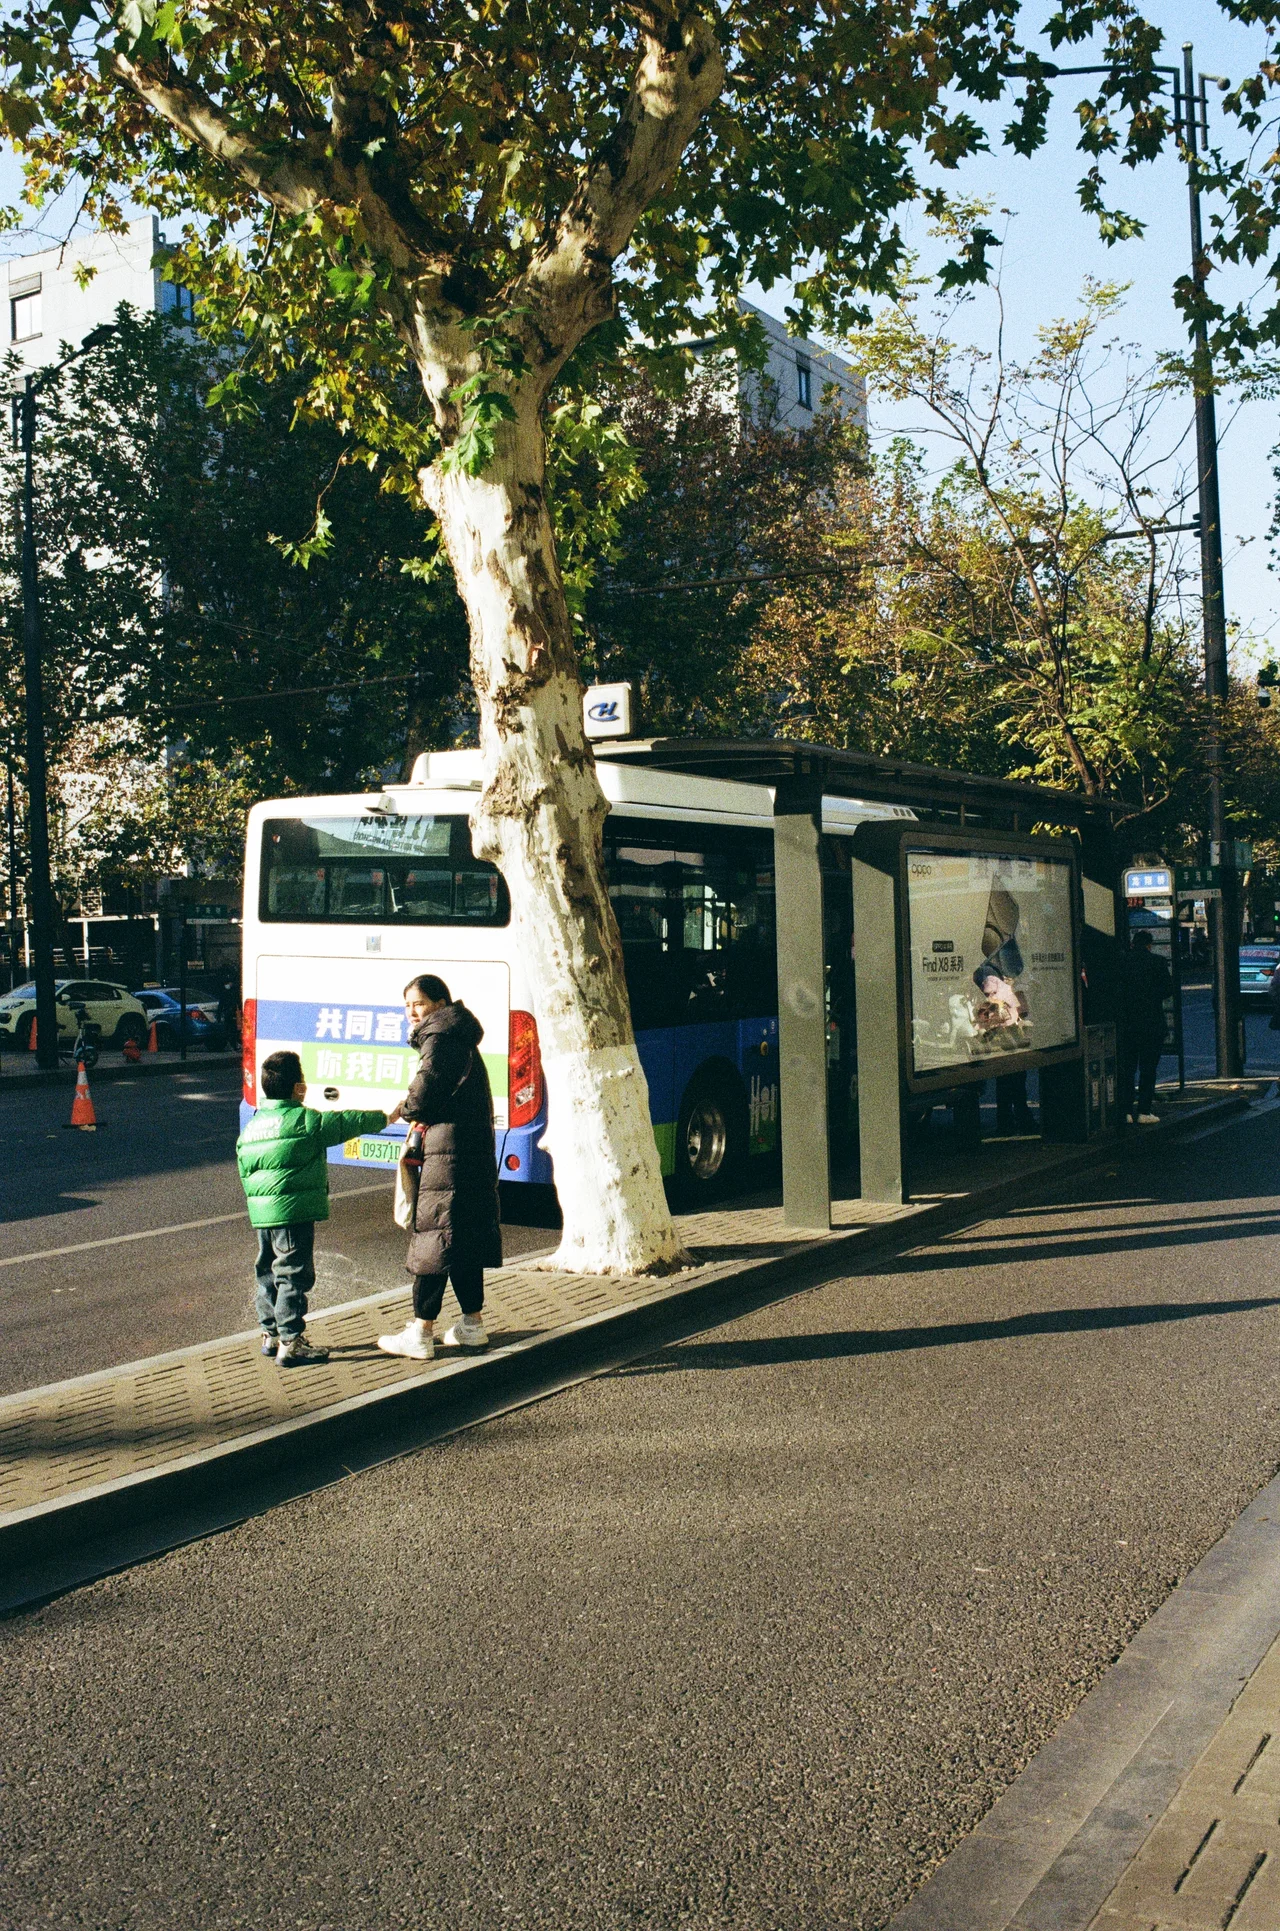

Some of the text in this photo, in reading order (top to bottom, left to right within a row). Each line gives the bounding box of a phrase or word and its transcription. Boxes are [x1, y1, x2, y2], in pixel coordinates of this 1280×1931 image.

[922, 956, 937, 973] Find
[316, 1008, 410, 1042] 共同富
